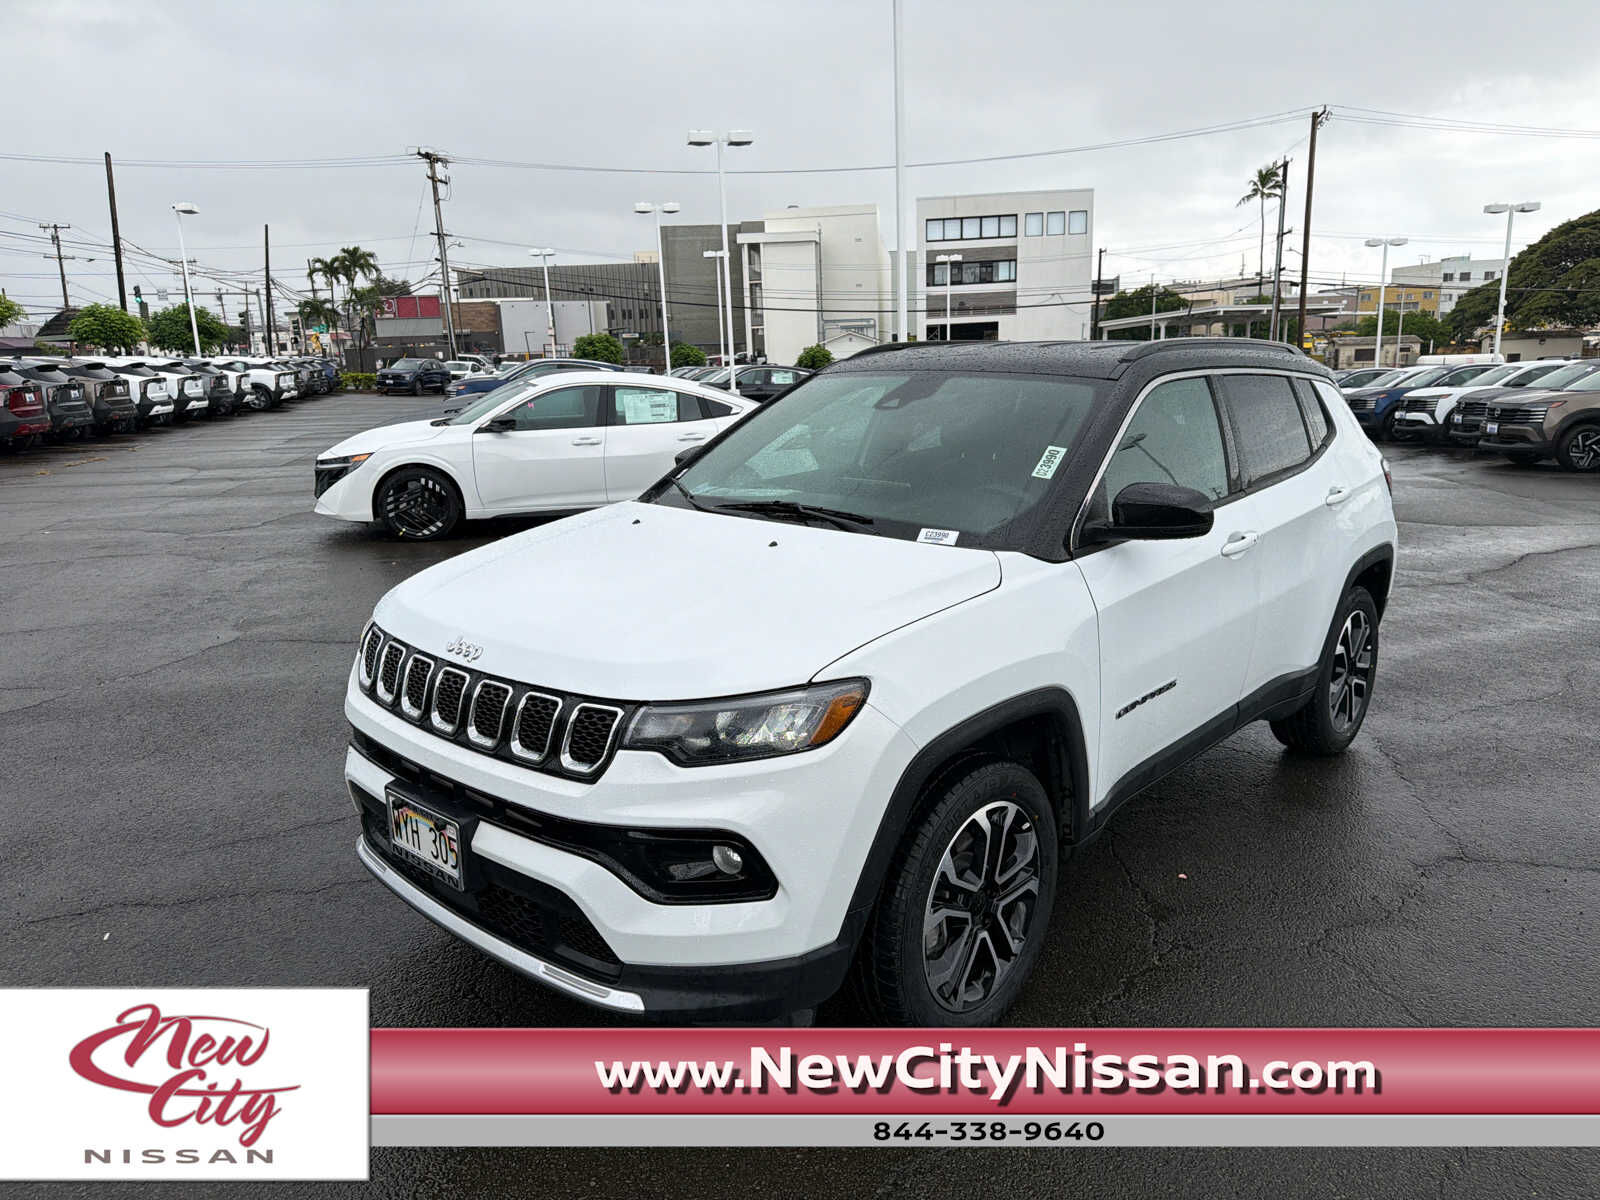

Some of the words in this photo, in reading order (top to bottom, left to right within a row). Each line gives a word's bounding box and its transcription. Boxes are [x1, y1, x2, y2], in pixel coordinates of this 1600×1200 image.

[446, 635, 484, 663] Jeep
[392, 808, 421, 851] WYH
[429, 826, 459, 870] 305
[392, 844, 460, 889] NISSAN
